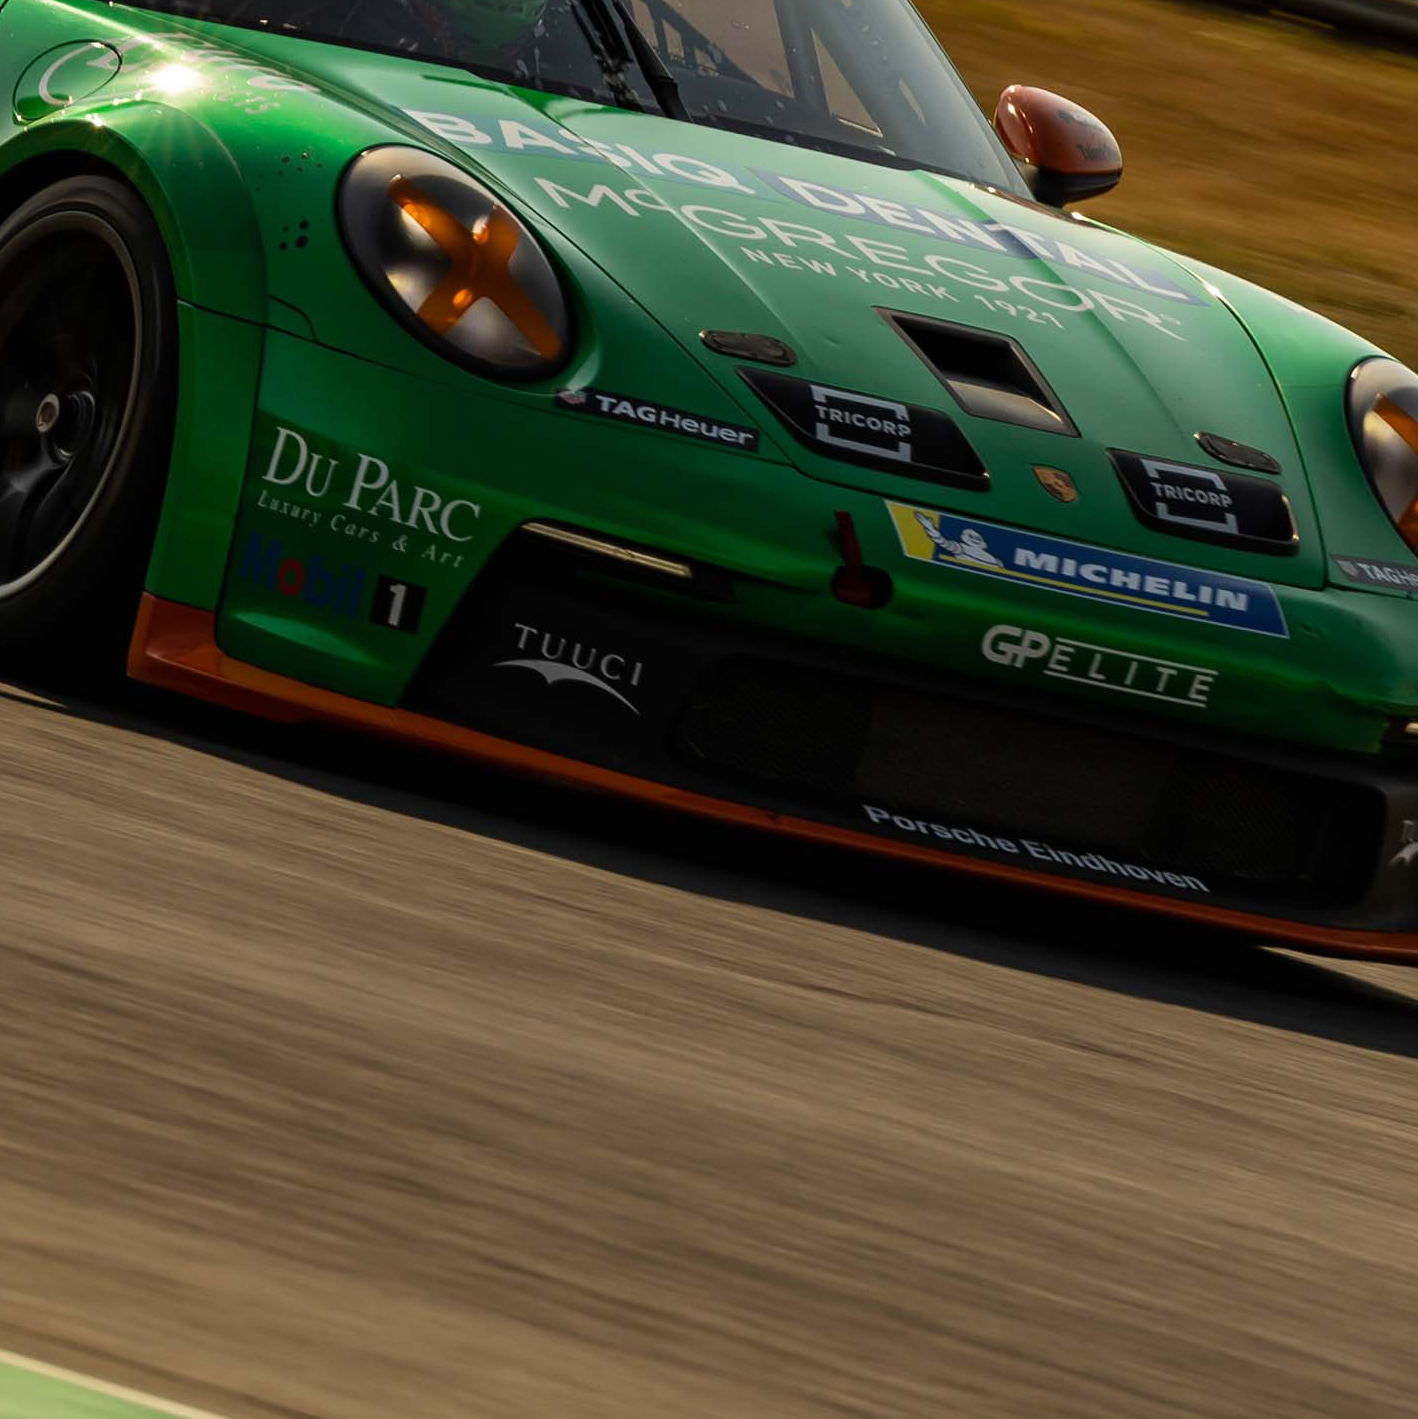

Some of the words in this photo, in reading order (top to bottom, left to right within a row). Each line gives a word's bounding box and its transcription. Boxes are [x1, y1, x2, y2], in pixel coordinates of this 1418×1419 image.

[406, 109, 756, 195] BASIQ
[777, 175, 1190, 301] DENTAL
[739, 246, 838, 279] NEW
[848, 264, 961, 303] YORK
[975, 293, 1064, 329] 1921
[813, 405, 913, 438] TRICORP
[256, 489, 323, 527] Luxury
[330, 513, 380, 544] Cars
[392, 534, 409, 554] &
[422, 544, 466, 570] Art
[1149, 481, 1232, 512] TRICORP
[238, 533, 364, 618] Mobil
[387, 582, 407, 629] 1
[1013, 546, 1251, 613] MICHELIN
[514, 623, 644, 687] TUUCI
[863, 804, 1019, 856] Porsche
[1026, 839, 1211, 894] Eindhoven
